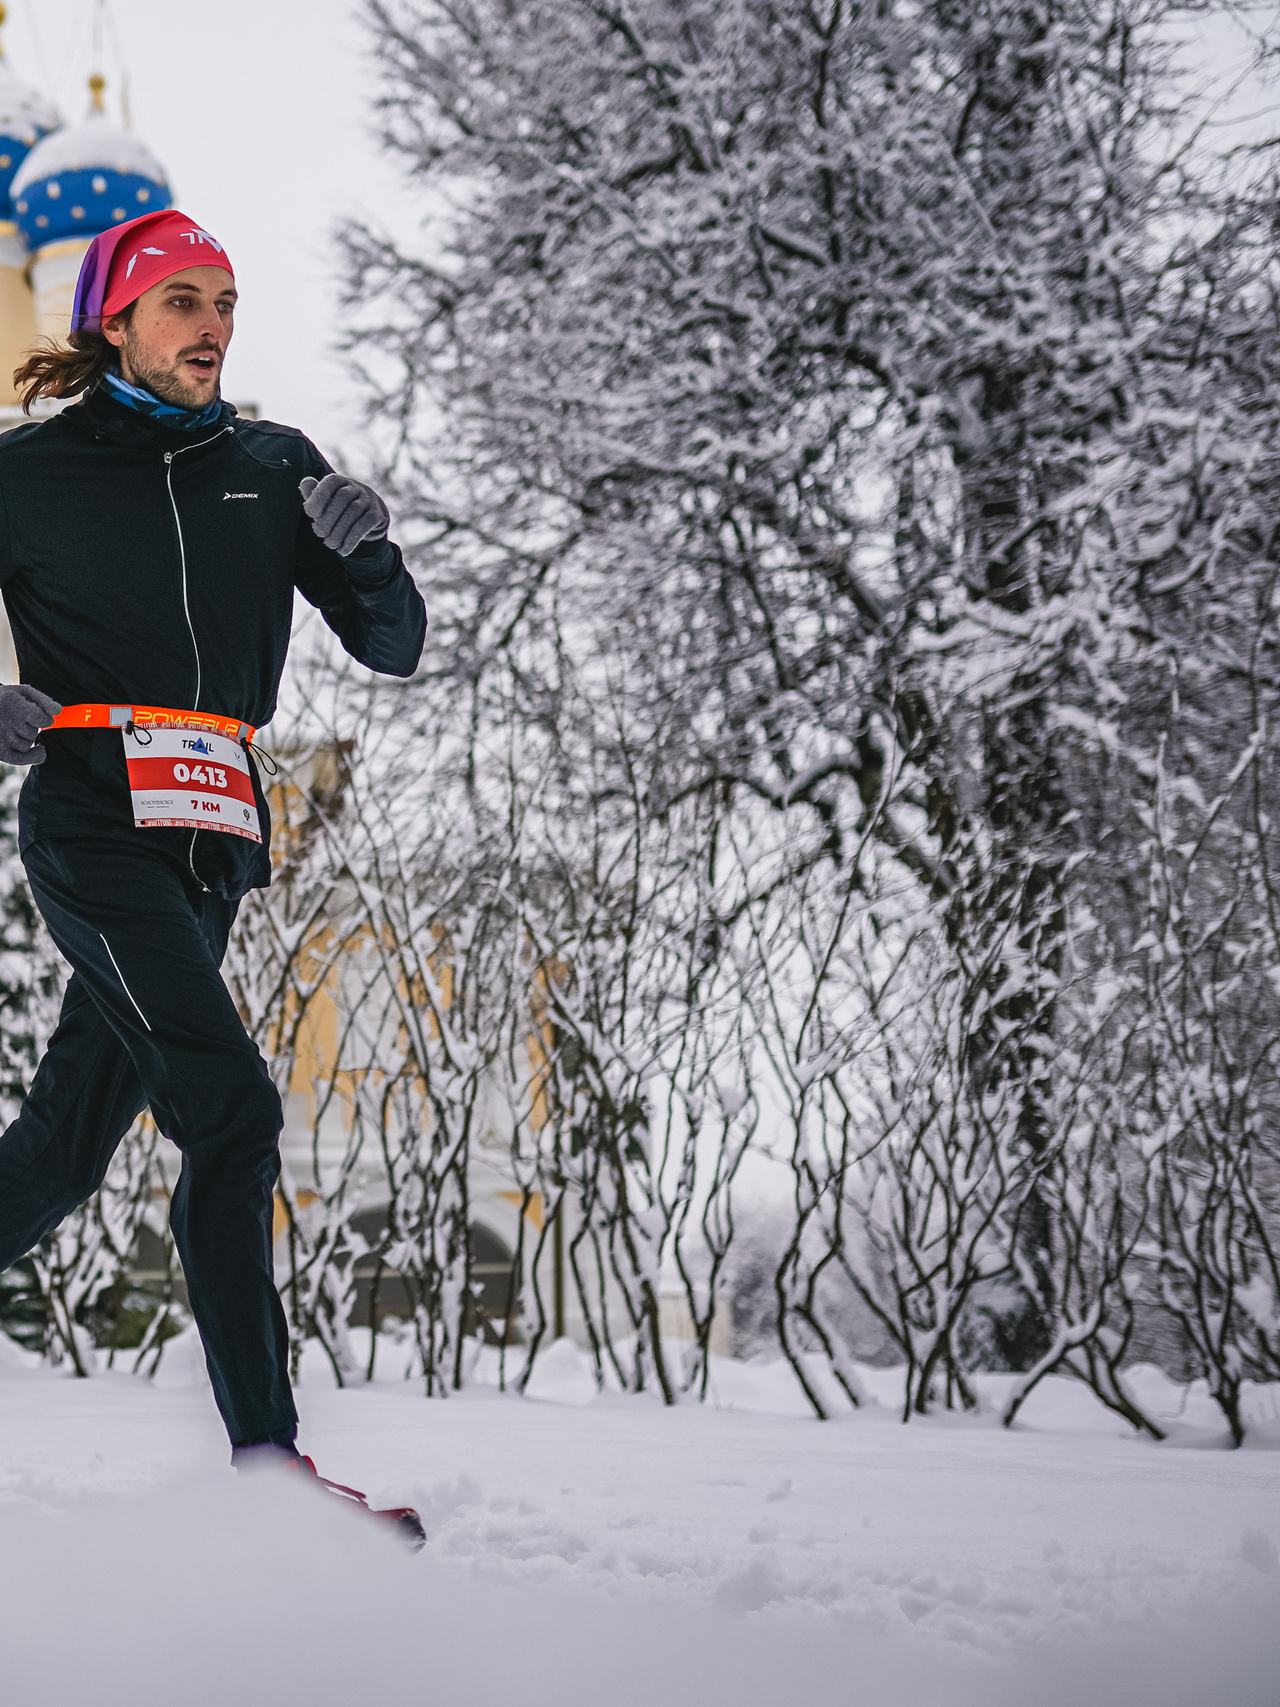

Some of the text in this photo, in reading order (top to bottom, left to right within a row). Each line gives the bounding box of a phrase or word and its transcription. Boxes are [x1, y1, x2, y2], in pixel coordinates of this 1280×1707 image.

[181, 737, 214, 755] TRAIL
[173, 763, 228, 788] 0413
[190, 799, 198, 810] 7
